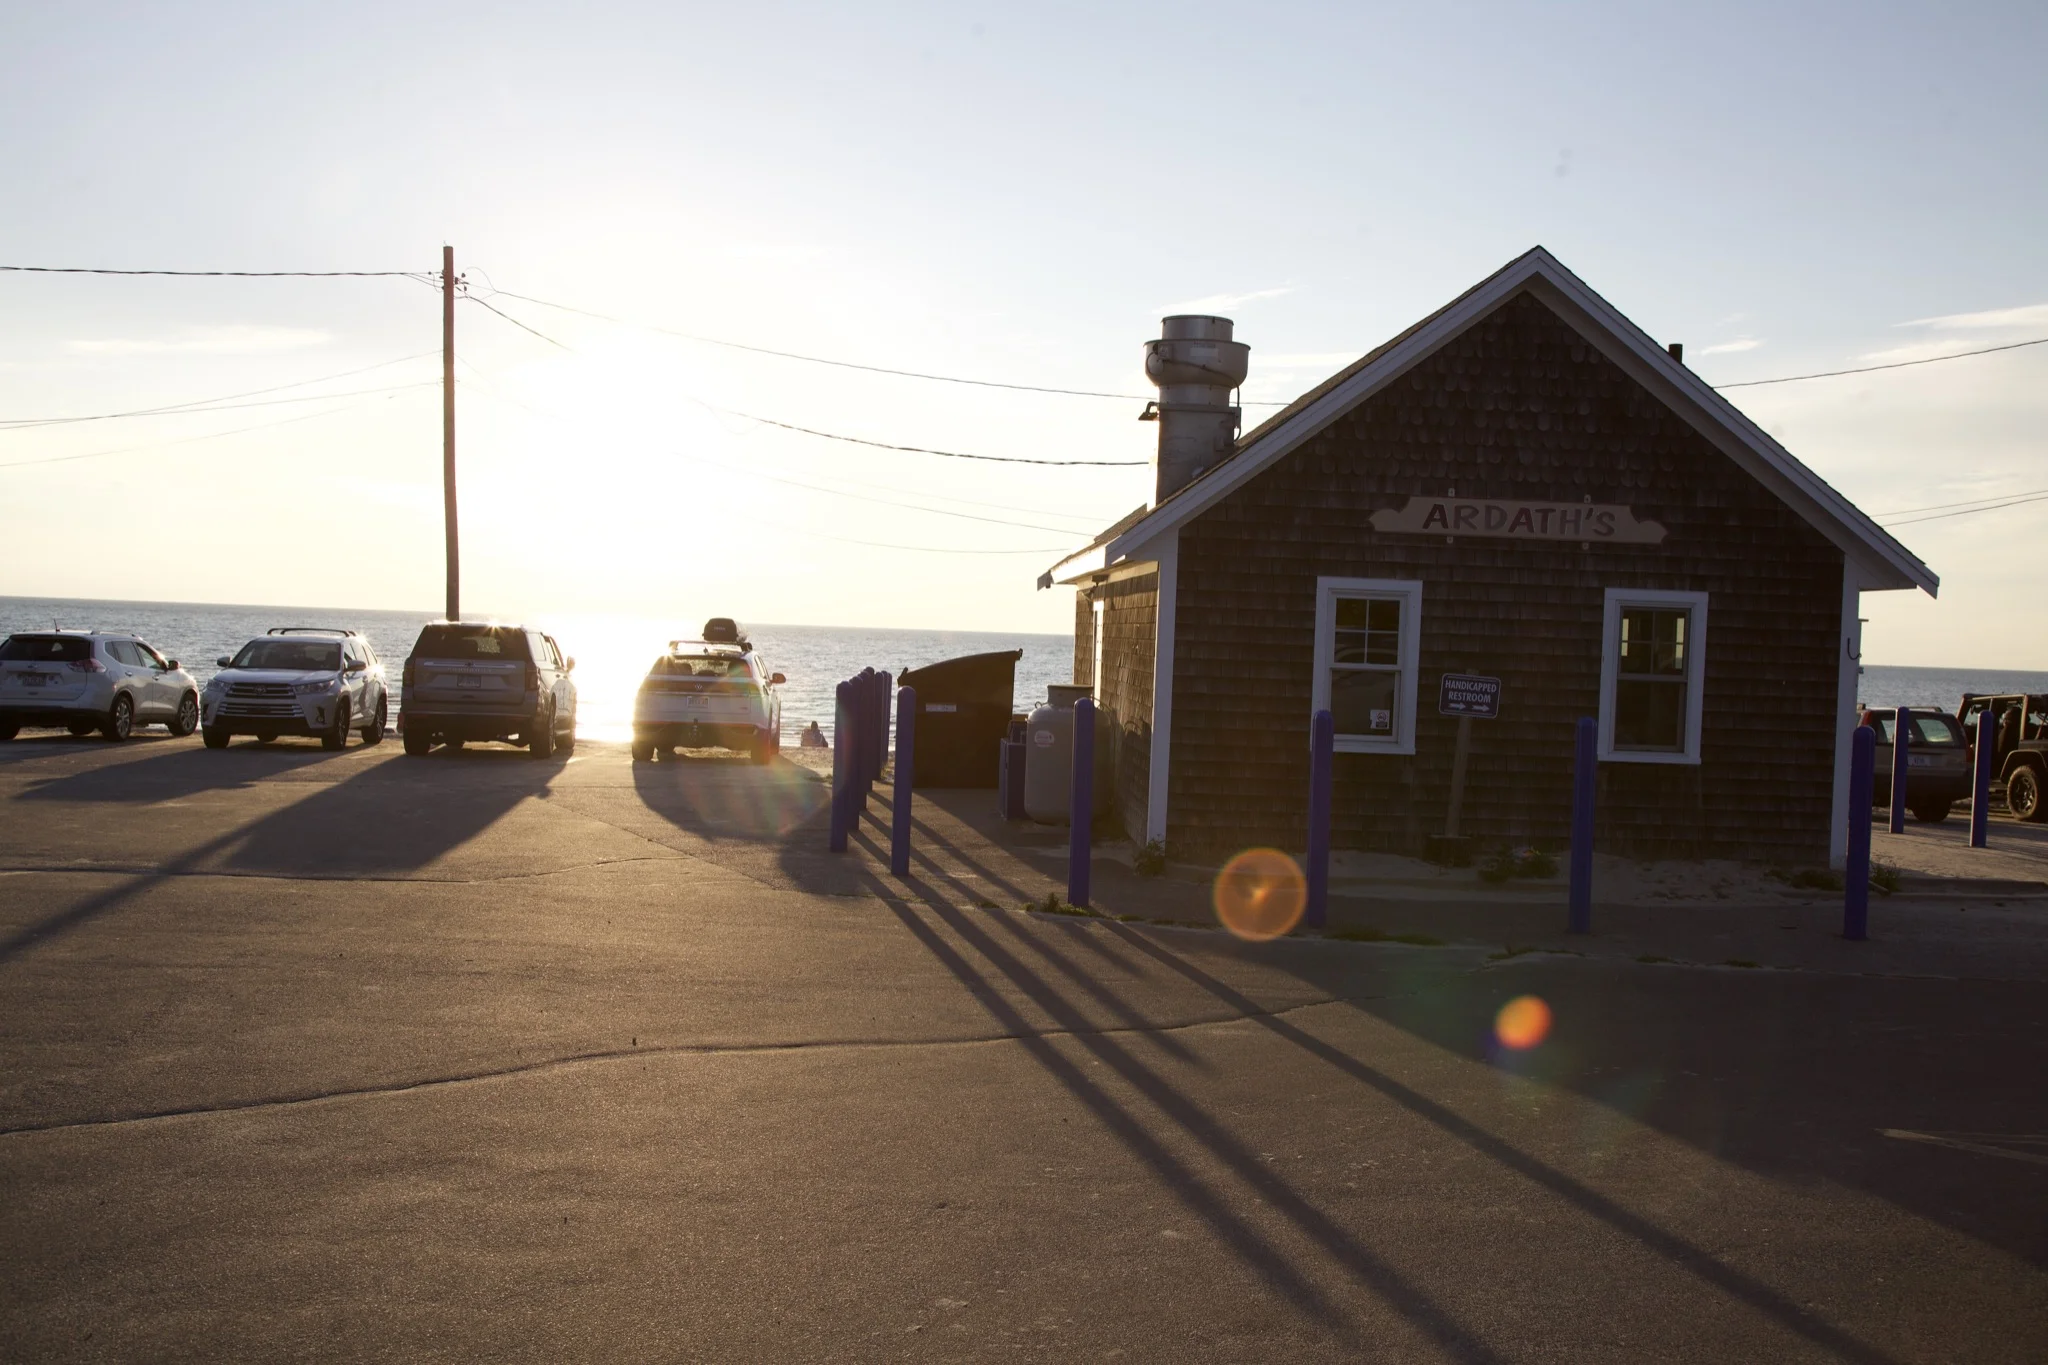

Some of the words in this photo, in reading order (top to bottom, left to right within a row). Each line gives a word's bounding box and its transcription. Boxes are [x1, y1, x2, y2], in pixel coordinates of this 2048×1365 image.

[1422, 503, 1616, 537] ARDATH'S
[1445, 679, 1497, 693] HANDICAPPED
[1448, 690, 1491, 703] RESTROOM
